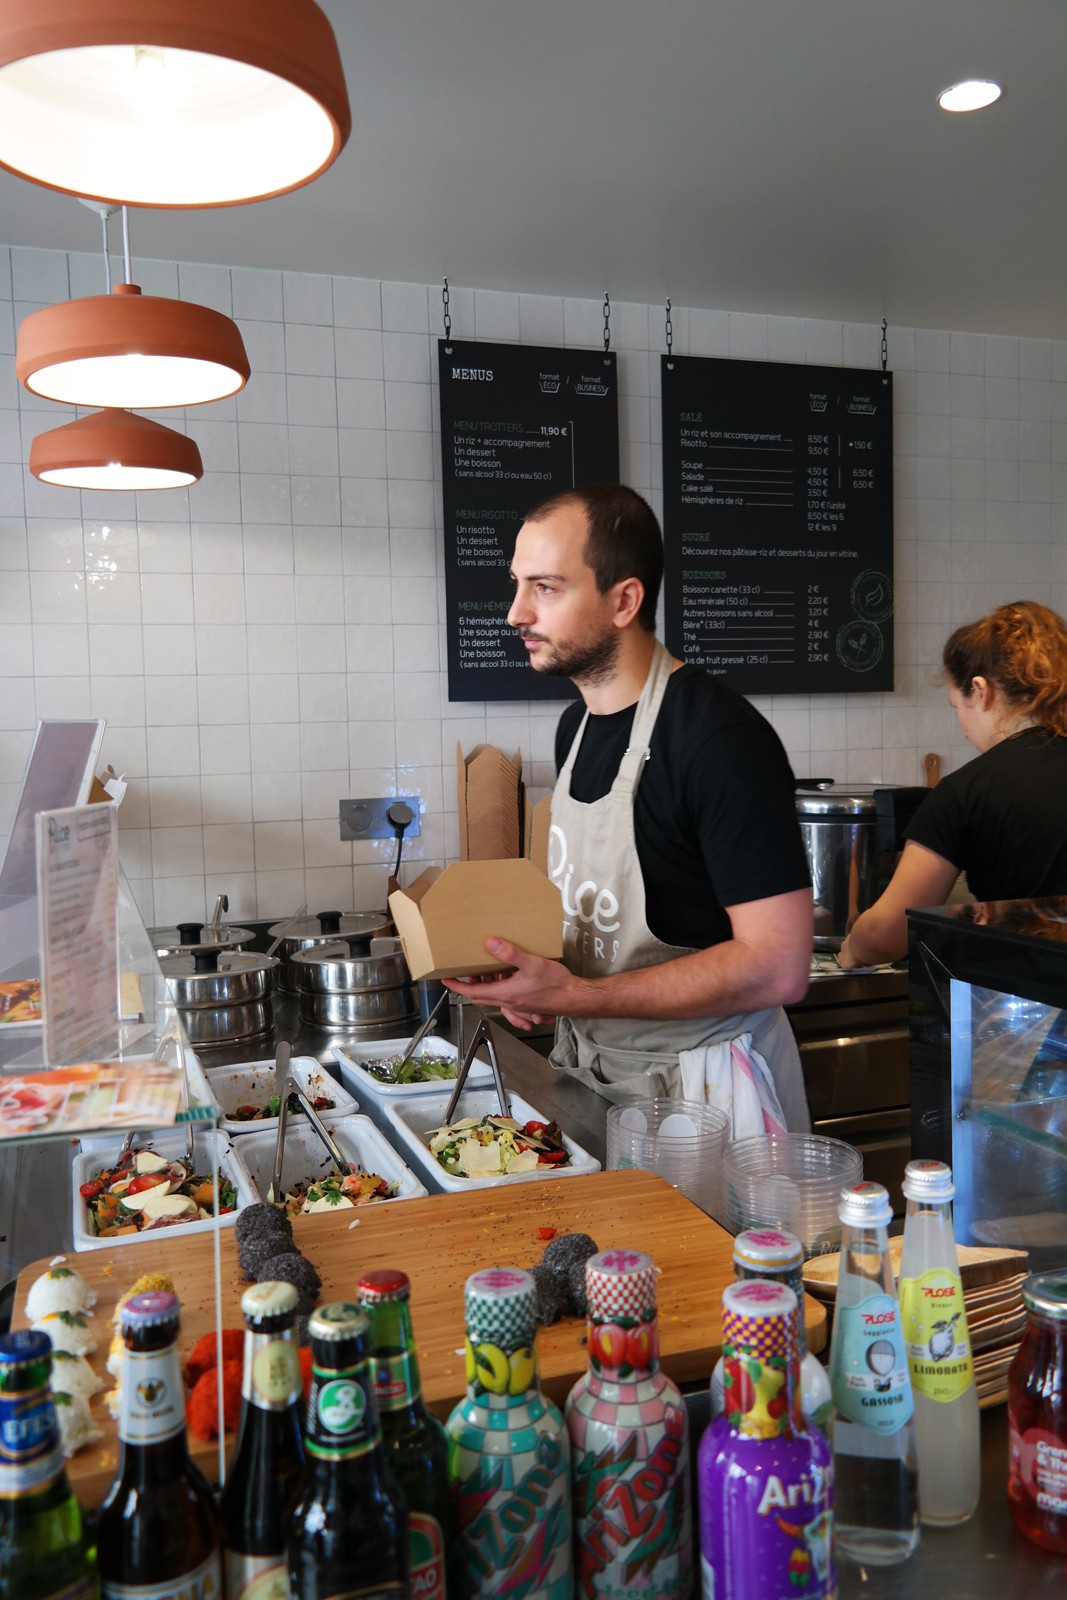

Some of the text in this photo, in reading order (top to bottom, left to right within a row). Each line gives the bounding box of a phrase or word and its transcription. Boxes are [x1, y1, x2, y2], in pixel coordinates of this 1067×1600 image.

[452, 368, 494, 381] MENUS
[540, 372, 601, 384] format format
[577, 384, 606, 392] BUSINESS
[454, 421, 568, 436] MENU TROTTERS 11,90 €
[680, 429, 690, 437] Un
[691, 430, 700, 438] riz
[700, 430, 708, 438] et
[724, 432, 782, 442] accompagnement
[823, 436, 830, 444] €
[454, 436, 464, 444] Un
[466, 437, 476, 445] riz
[484, 438, 550, 450] accompagnement
[680, 439, 707, 448] Risotto
[824, 448, 830, 456] €
[866, 442, 872, 450] €
[454, 447, 496, 456] Un dessert
[454, 458, 502, 468] Une boisson
[682, 461, 703, 470] Soupe
[822, 468, 828, 476] €
[868, 469, 874, 478] €
[474, 470, 494, 478] alcool
[534, 472, 542, 480] 50
[542, 472, 552, 480] cl)
[682, 472, 704, 480] Salade
[822, 478, 828, 486] €
[868, 480, 874, 488] €
[682, 484, 698, 492] Cake
[700, 484, 714, 492] salé
[822, 489, 828, 497] €
[682, 496, 724, 505] Hémisphères
[820, 501, 826, 510] €
[456, 510, 518, 520] MENU RISOTTO
[822, 512, 828, 520] €
[456, 526, 496, 534] Un risotto
[808, 523, 837, 532] 12 € les 9
[456, 536, 498, 545] Un dessert
[457, 548, 504, 556] Une boisson
[682, 546, 718, 556] Découvrez
[720, 548, 732, 556] nos
[769, 548, 776, 556] et
[807, 550, 814, 558] du
[814, 550, 828, 559] jour
[682, 570, 726, 580] BOISSONS
[682, 585, 710, 594] Boisson
[710, 586, 738, 594] canette
[808, 585, 812, 593] 2
[458, 602, 482, 610] MENU
[682, 598, 696, 606] Eau
[698, 597, 725, 606] minérale
[823, 597, 828, 605] €
[683, 610, 706, 618] Autres
[707, 610, 736, 618] boissons
[753, 610, 774, 618] alcool
[823, 608, 828, 616] €
[459, 617, 508, 626] 6 hémisphère
[808, 620, 813, 628] 4
[814, 620, 820, 628] €
[459, 628, 474, 636] Une
[476, 629, 500, 638] soupe
[684, 632, 697, 641] Thé
[824, 631, 829, 639] €
[472, 638, 501, 647] dessert
[684, 642, 819, 652] Café 2 €
[460, 650, 506, 658] Une boisson
[480, 660, 499, 668] alcool
[500, 660, 508, 668] 33
[509, 660, 514, 668] cl
[696, 656, 705, 664] de
[706, 656, 720, 664] fruit
[722, 656, 744, 665] pressé
[824, 654, 829, 662] €
[562, 920, 620, 962] TTERS
[921, 1286, 956, 1298] PLOSE
[861, 1311, 896, 1325] PLOSE
